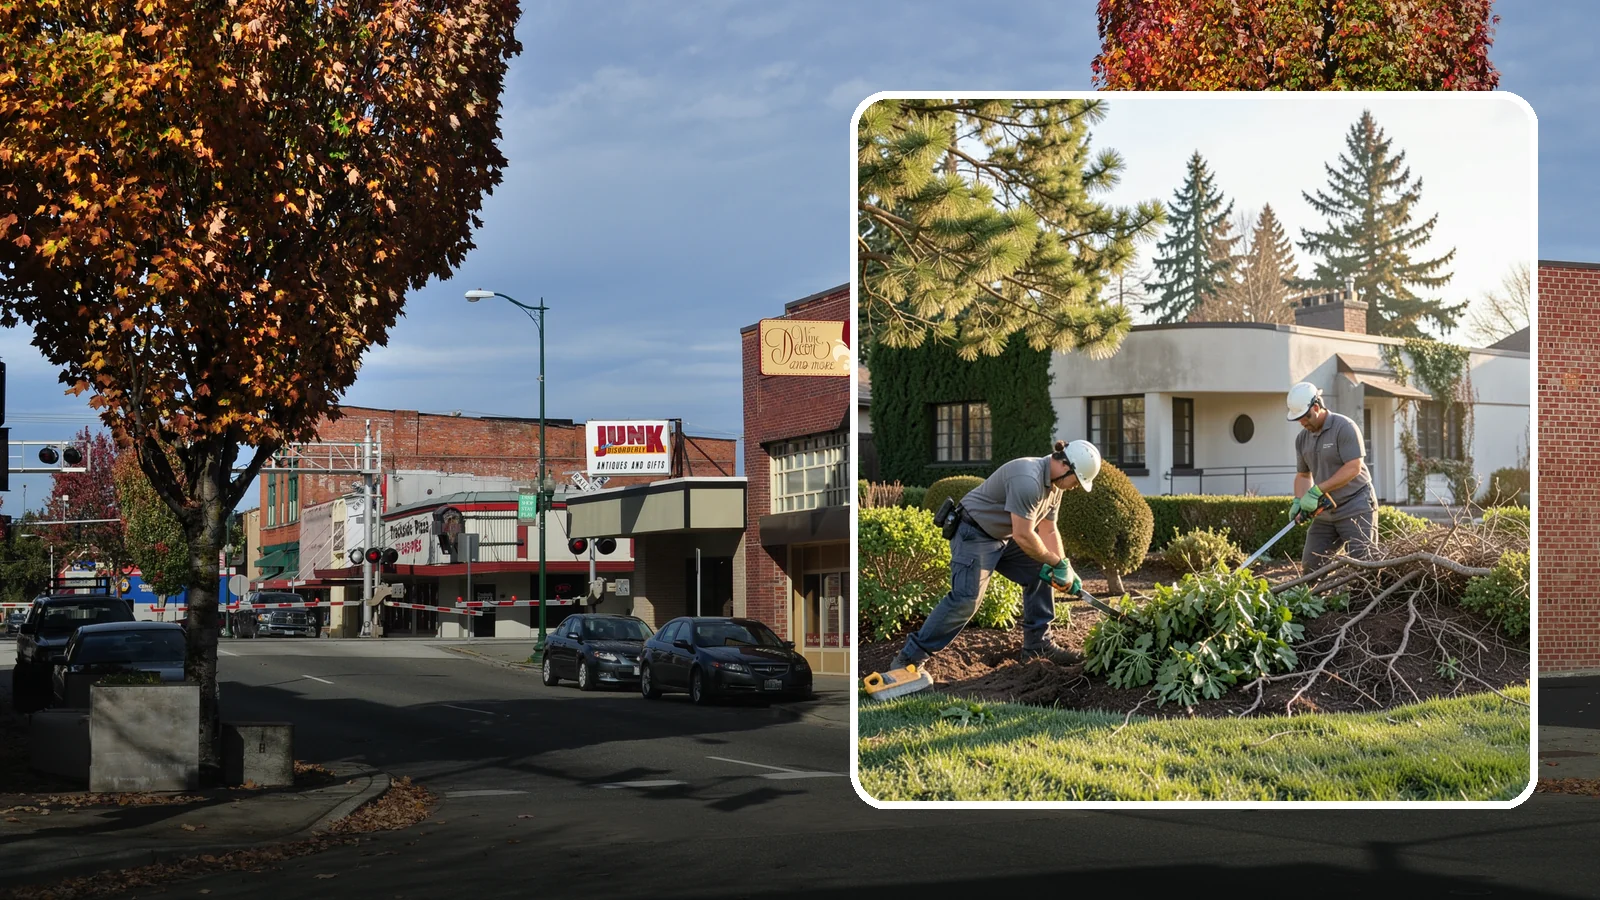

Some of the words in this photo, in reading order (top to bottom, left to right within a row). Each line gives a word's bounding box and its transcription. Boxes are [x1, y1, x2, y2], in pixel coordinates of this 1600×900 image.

[596, 425, 665, 457] JUNK
[607, 446, 646, 454] DISORDERLY
[596, 461, 628, 470] ANTIQUES
[631, 461, 644, 470] AND
[647, 460, 665, 470] GIFTS
[414, 519, 429, 535] Pizza
